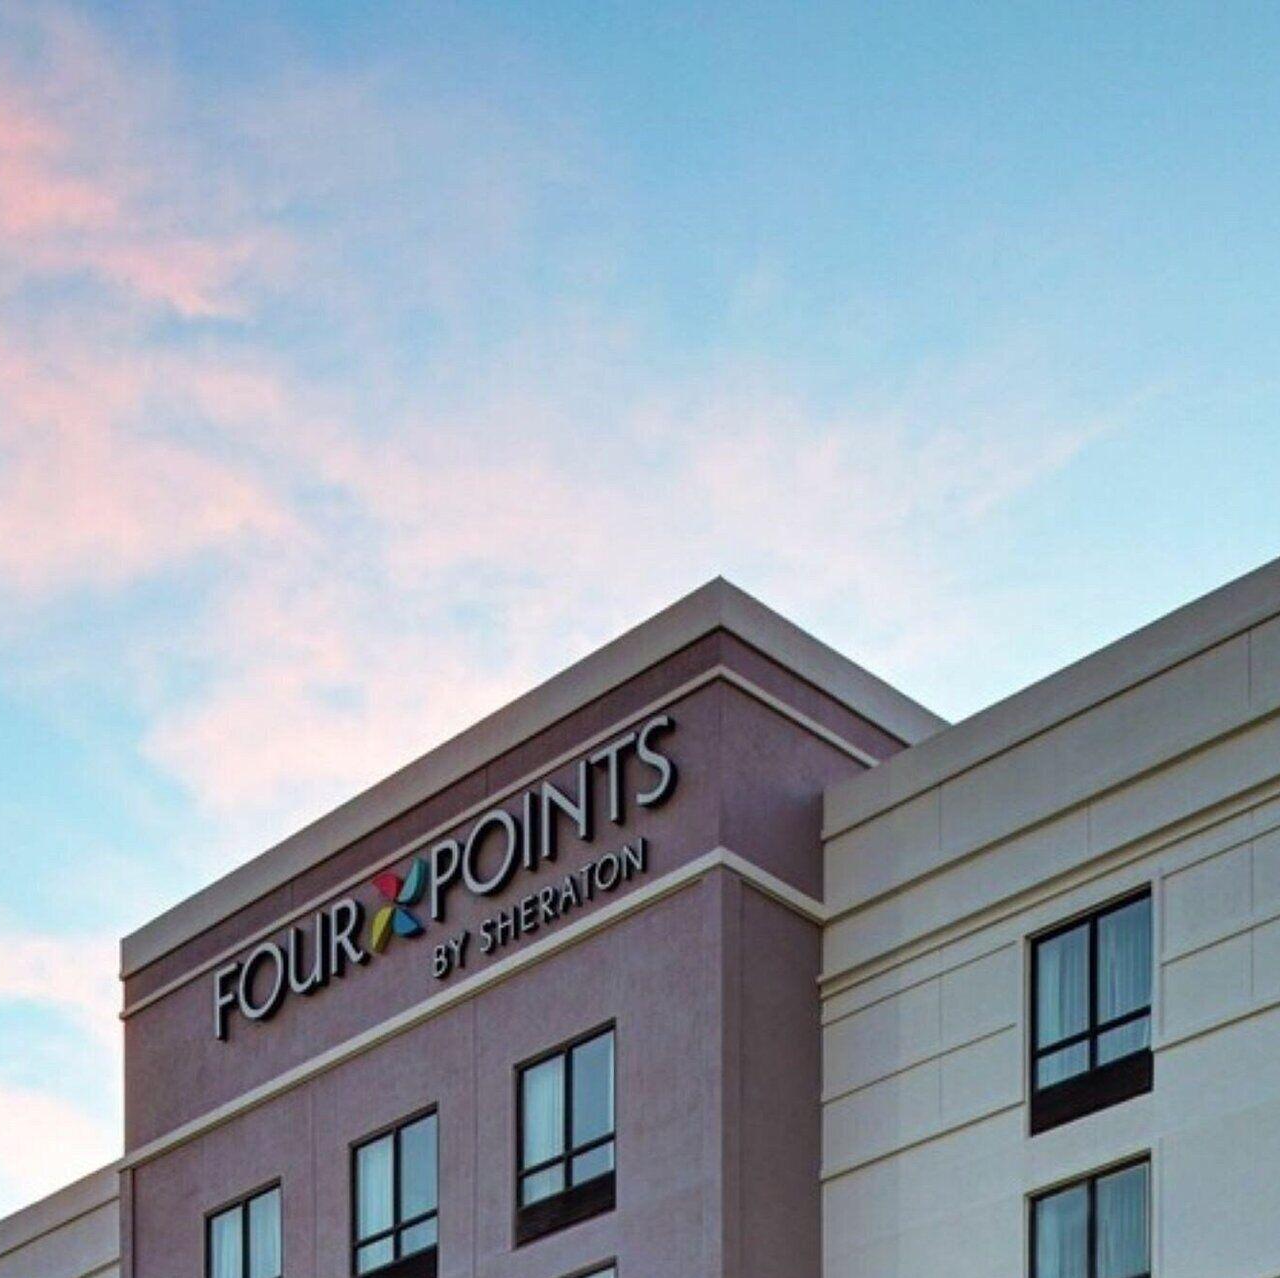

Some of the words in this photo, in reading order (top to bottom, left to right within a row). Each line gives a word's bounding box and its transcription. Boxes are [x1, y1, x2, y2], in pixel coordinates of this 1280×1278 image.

[212, 898, 371, 1041] FOUR
[430, 715, 678, 922] POINTS
[432, 932, 469, 979] BY
[479, 837, 649, 956] SHERATON
